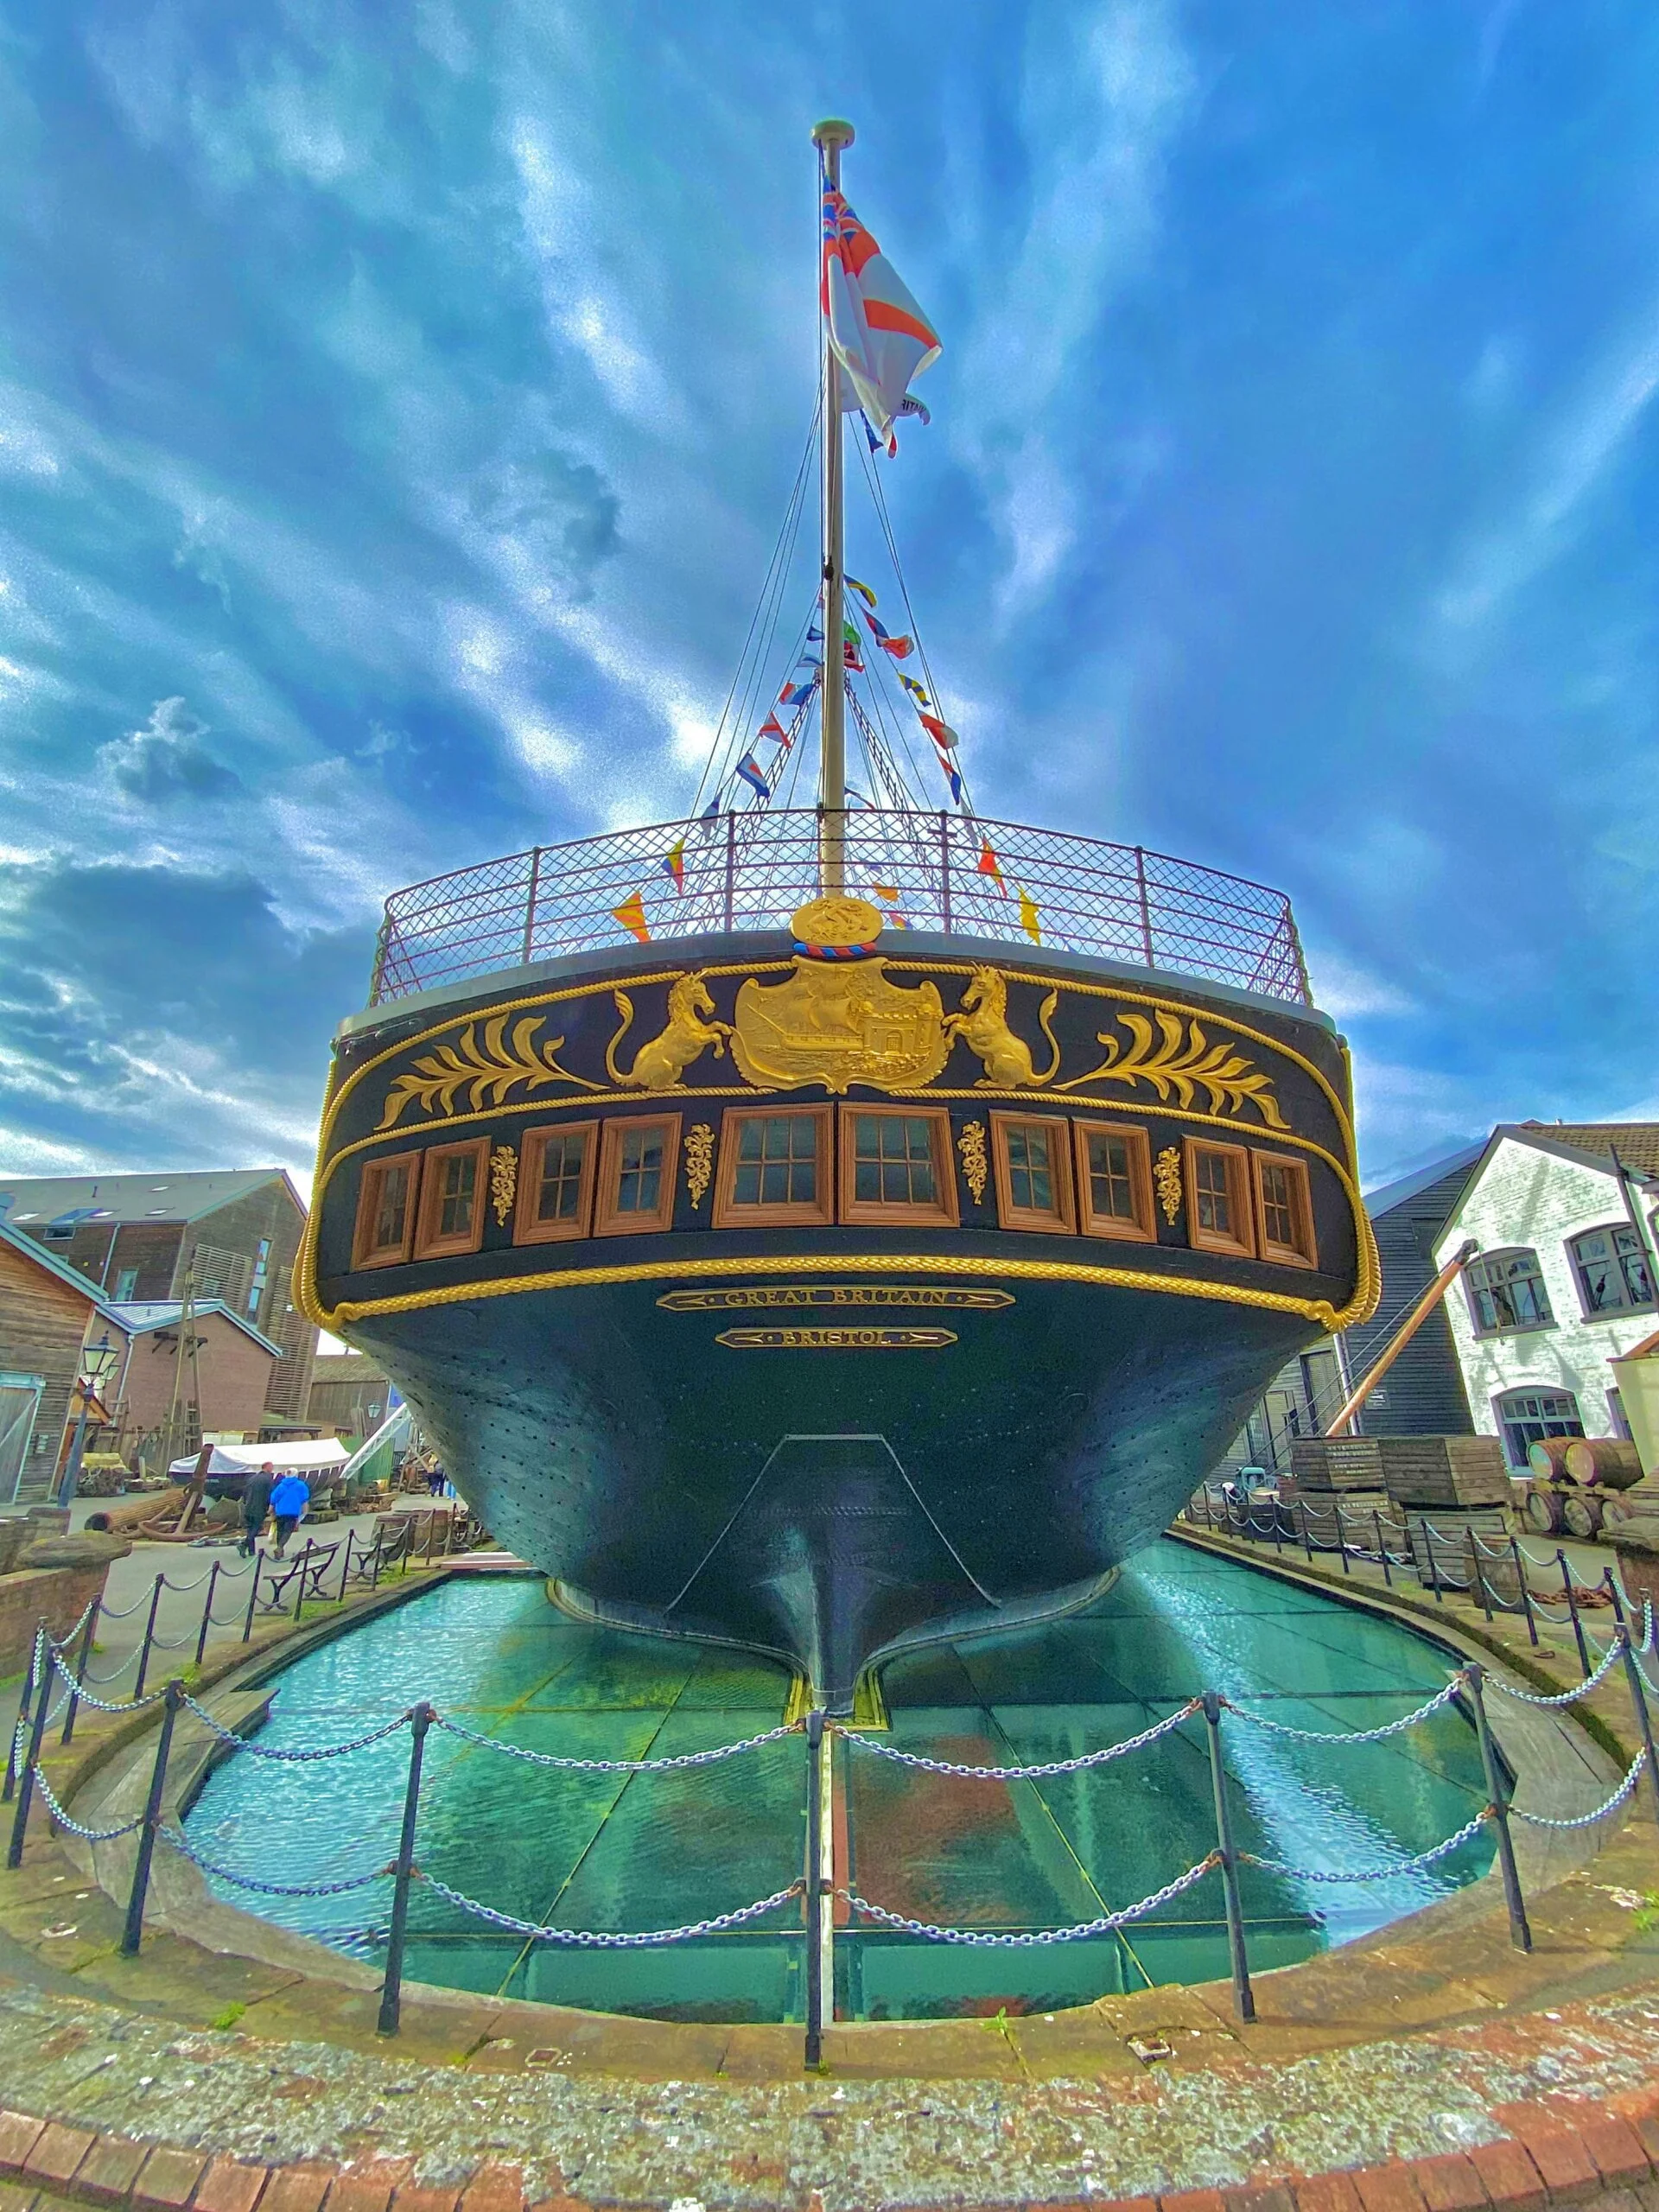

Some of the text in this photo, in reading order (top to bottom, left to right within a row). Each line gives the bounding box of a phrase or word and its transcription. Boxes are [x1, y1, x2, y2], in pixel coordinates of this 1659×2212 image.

[725, 1289, 948, 1306] GREAT BRITAIN
[781, 1331, 891, 1344] BRISTOL
